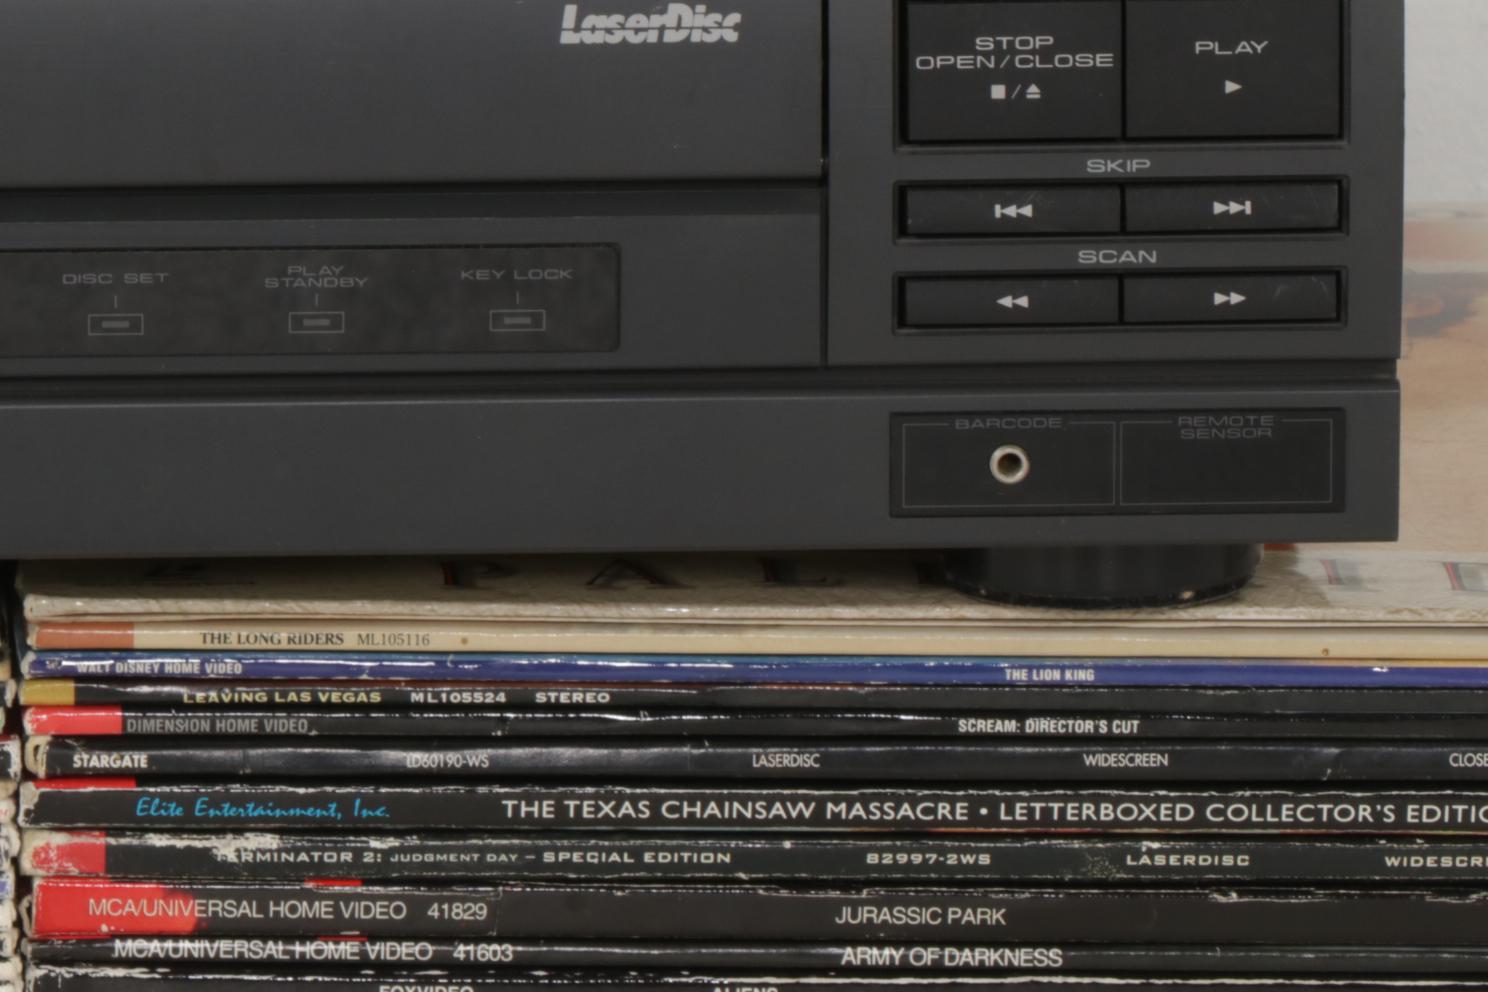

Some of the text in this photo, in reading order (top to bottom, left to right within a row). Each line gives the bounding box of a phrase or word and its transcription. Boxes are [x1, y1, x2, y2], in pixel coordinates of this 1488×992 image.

[559, 2, 742, 45] LaserDisc
[975, 35, 1055, 51] STOP
[1195, 40, 1269, 55] PLAY
[915, 53, 1115, 70] OPEN/CLOSE
[1086, 158, 1152, 173] SKIP
[1077, 249, 1157, 264] SCAN
[287, 264, 345, 276] PLAY
[460, 267, 574, 281] KEY LOCK
[62, 272, 170, 286] DISC SET
[264, 276, 370, 289] STANDBY
[954, 417, 1063, 430] BARCODE
[1177, 415, 1276, 427] REMOTE
[1179, 427, 1274, 440] SENSOR
[200, 632, 431, 647] THE LONG RIDERS ML105116
[77, 662, 243, 675] WALT DISNEY HOME VIDEO
[1005, 669, 1095, 681] THE LION KING
[183, 691, 611, 704] LEAVING LAS VEGAS ML105524 STEREO
[126, 718, 308, 734] DIMENSION HOME VIDEO
[958, 719, 1140, 734] SCREAM: DIRECTOR'S CUT
[72, 754, 149, 769] STARGATE
[752, 753, 821, 768] LASERDISC
[1083, 753, 1169, 767] WIDESCREEN
[135, 796, 185, 817] Elite
[194, 797, 343, 820] Entertainment,
[353, 798, 391, 818] Inc.
[502, 800, 555, 818] THE
[563, 800, 651, 819] TEXAS
[661, 801, 816, 820] CHAINSAW
[825, 802, 970, 821] MASSACRE
[1000, 803, 1195, 822] LETTERBOXED
[1206, 803, 1396, 823] COLLECTOR'S
[361, 851, 383, 864] 2:
[390, 852, 480, 863] JUDGMENT
[486, 852, 519, 863] DAY
[543, 851, 635, 864] SPECIAL
[644, 851, 732, 864] EDITION
[1126, 854, 1250, 866] LASERDISC
[88, 898, 1007, 925] MCA/UNIVERSAL HOME VIDEO 41829 JURASSIC PARK
[114, 939, 1063, 967] MCA/UNIVERSAL HOME VIDEO 41603 ARMY OF DARKNESS
